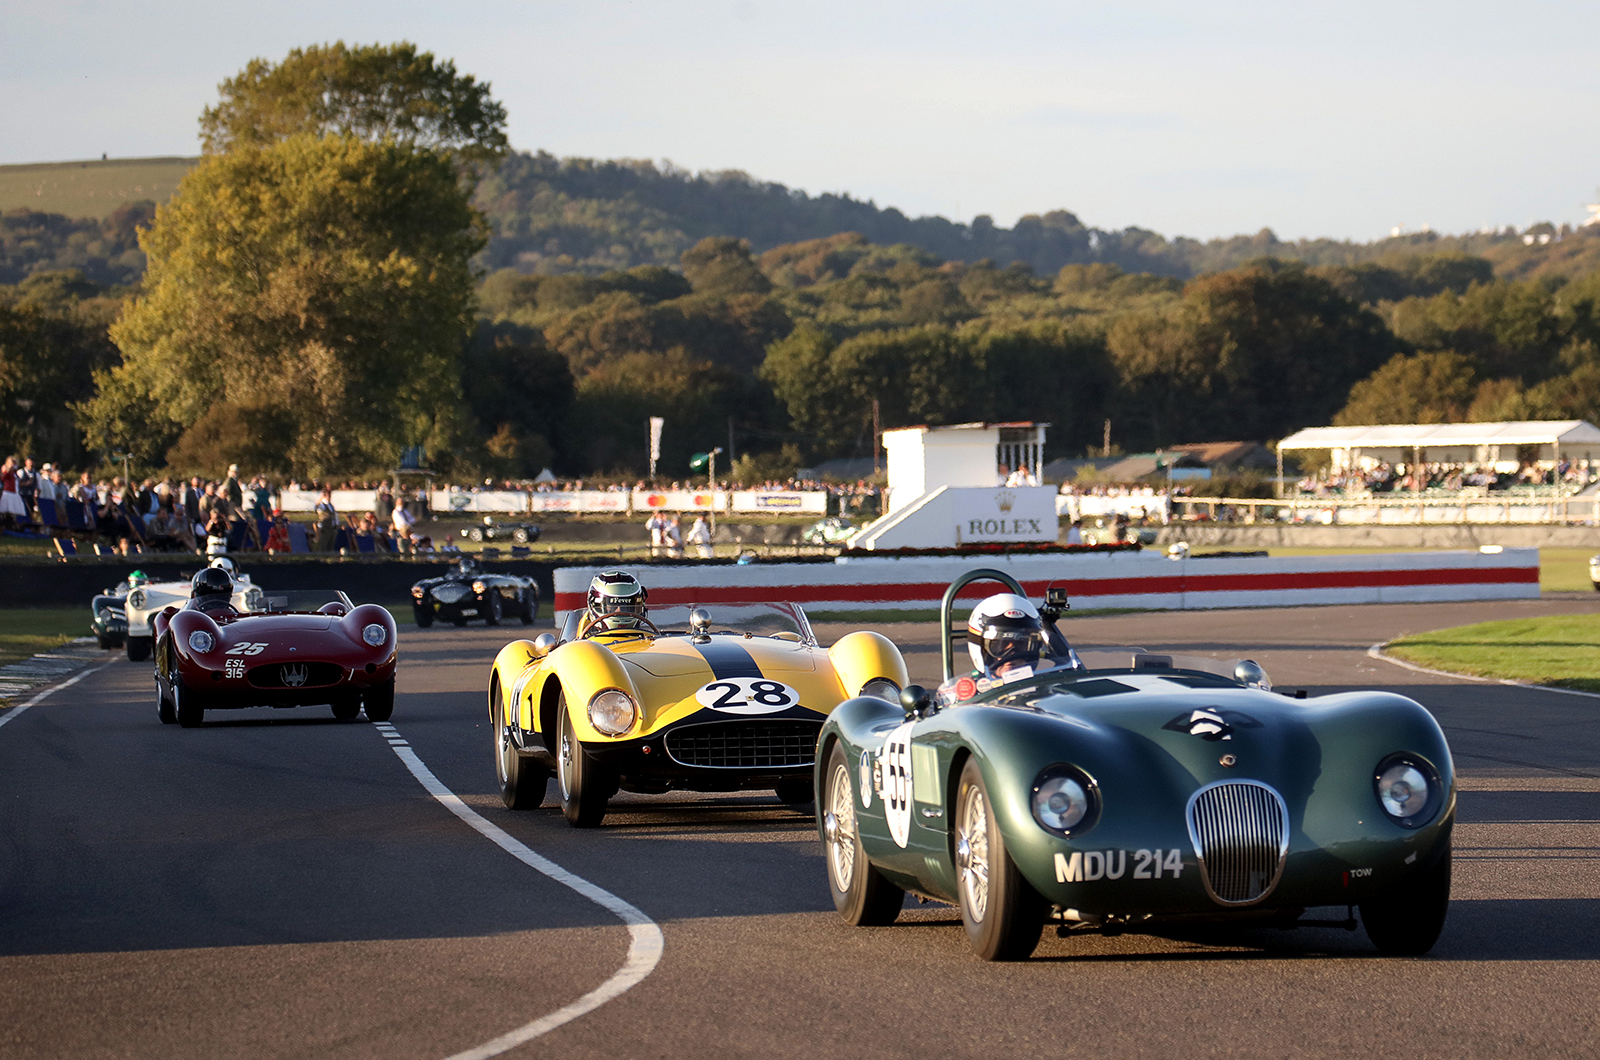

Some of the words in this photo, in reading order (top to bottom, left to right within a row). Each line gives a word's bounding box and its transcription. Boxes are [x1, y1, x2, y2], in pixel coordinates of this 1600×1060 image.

[968, 518, 1042, 535] ROLEX
[224, 642, 269, 655] 25
[225, 659, 246, 668] ESL
[225, 667, 244, 679] 315
[705, 681, 792, 708] 28
[889, 742, 906, 811] 55
[1054, 850, 1125, 884] MDU
[1133, 848, 1184, 880] 214
[1350, 868, 1373, 878] TOW
